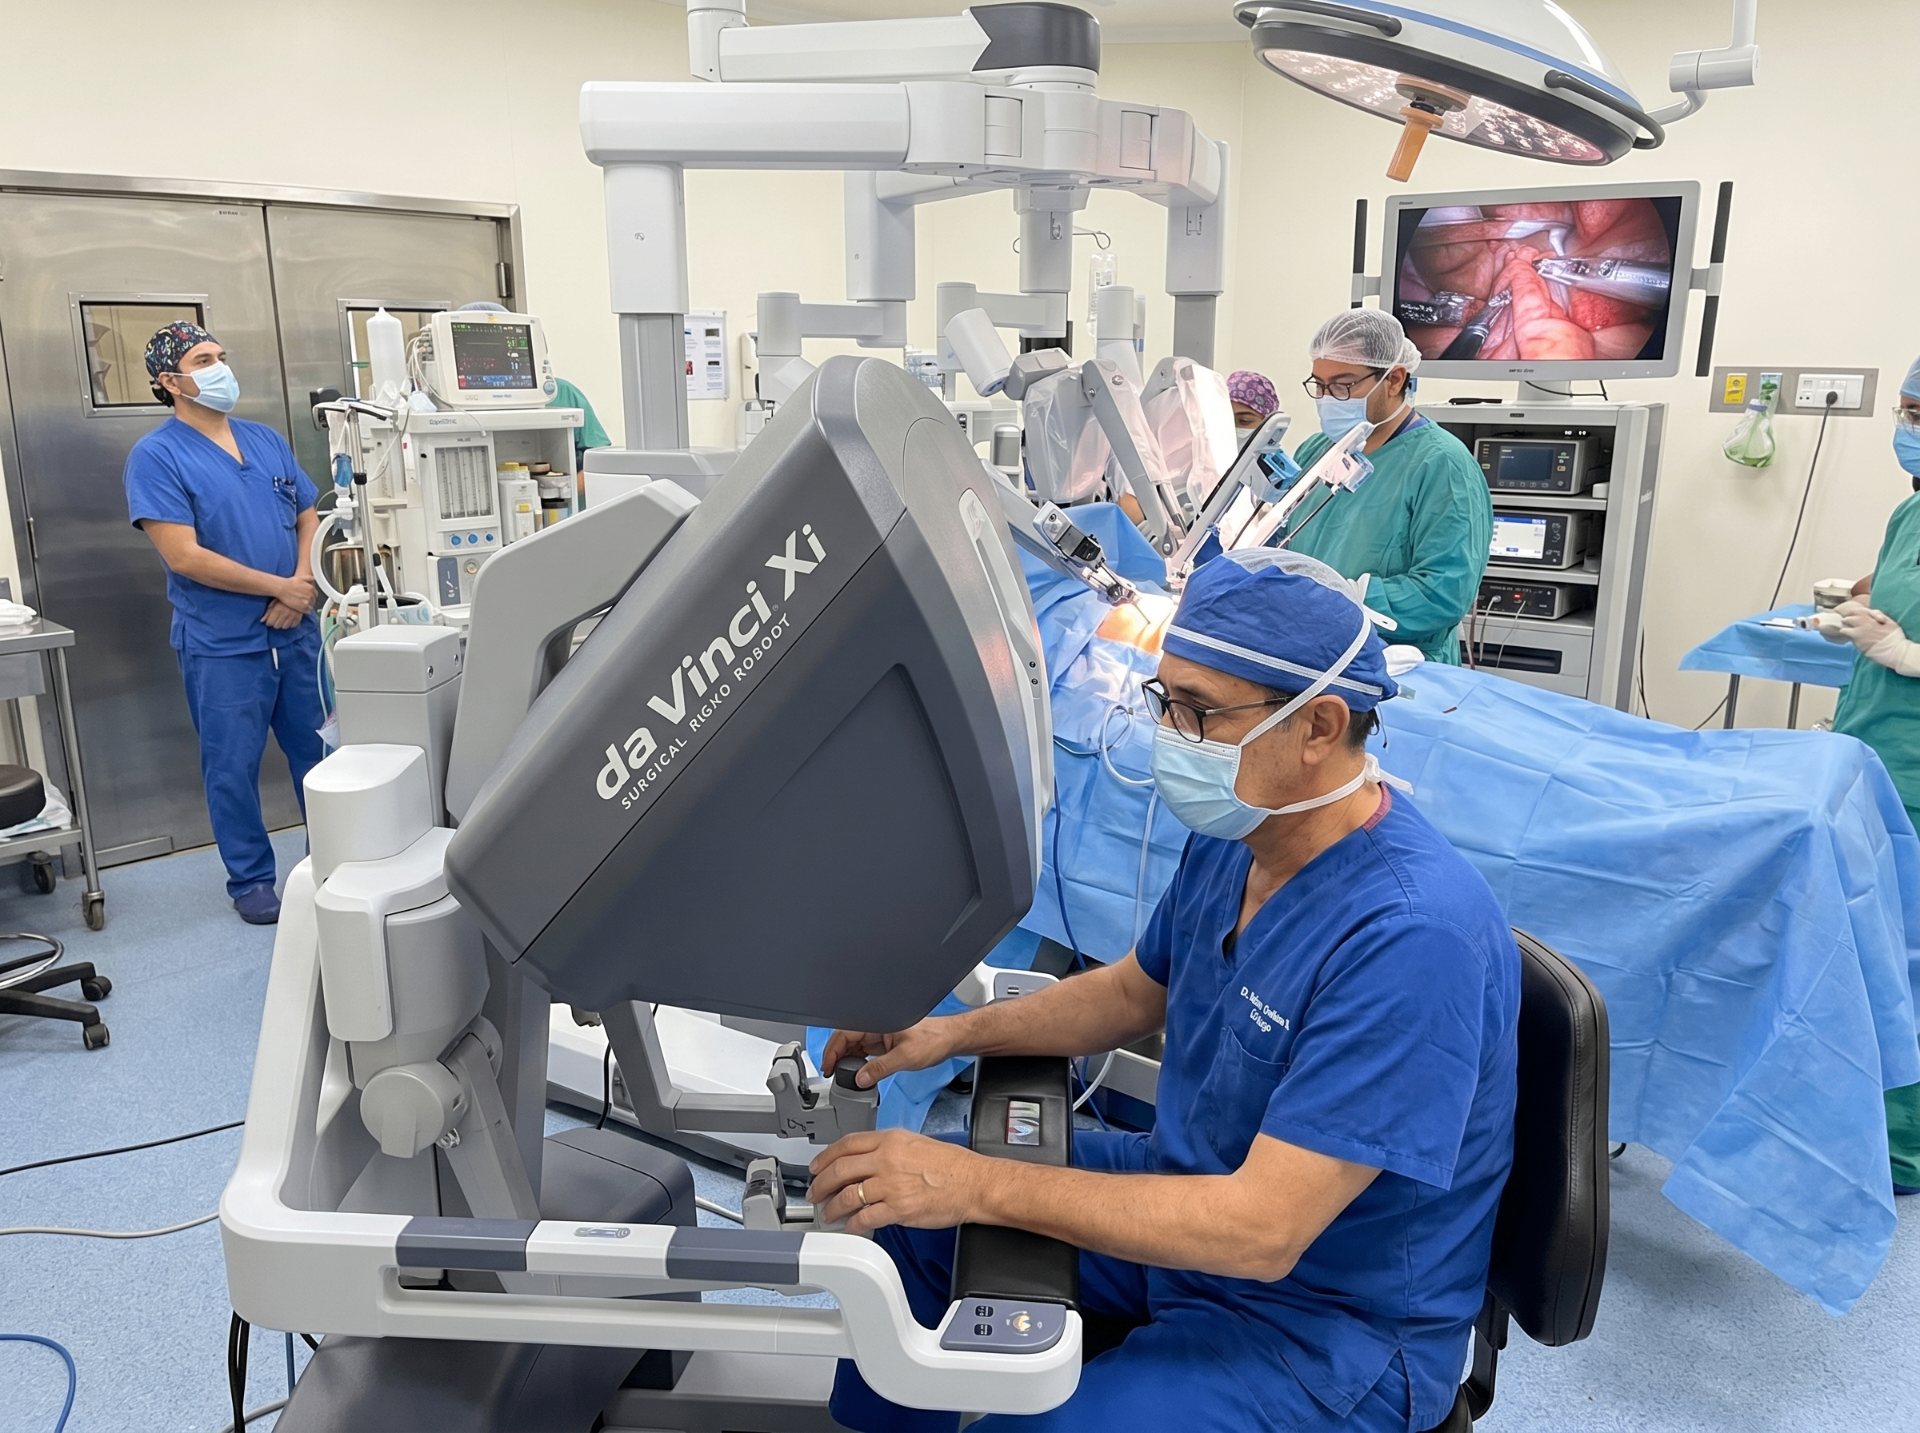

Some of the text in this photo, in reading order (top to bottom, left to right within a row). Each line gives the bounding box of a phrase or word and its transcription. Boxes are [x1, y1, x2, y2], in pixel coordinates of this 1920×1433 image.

[597, 523, 827, 800] da Vinci Xi
[621, 737, 688, 810] SURGICAL
